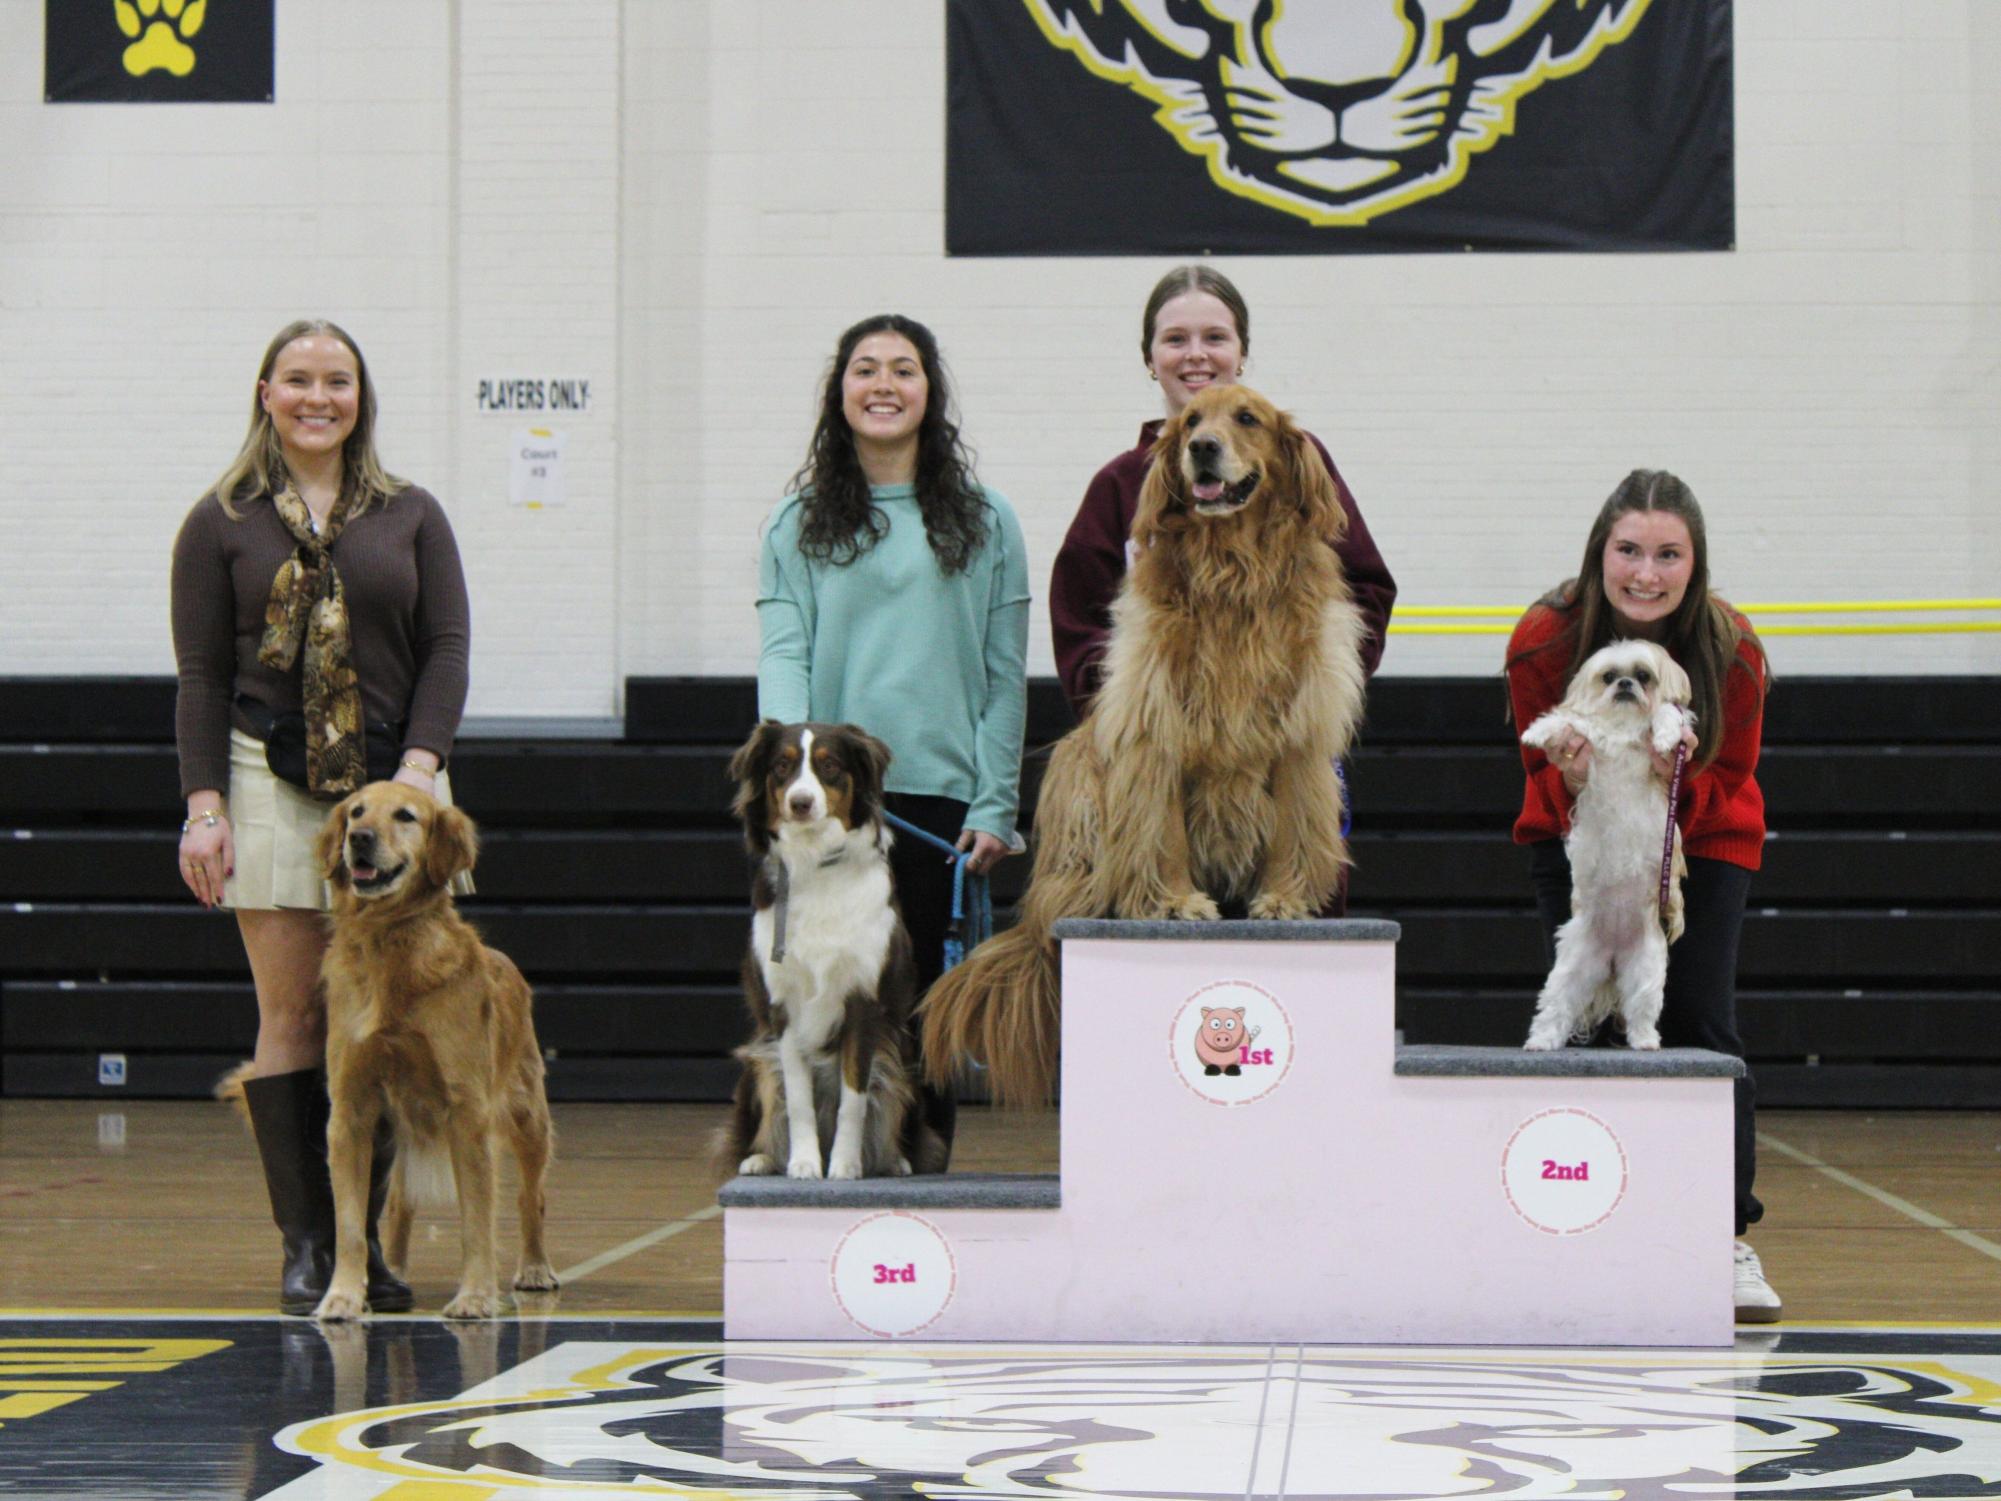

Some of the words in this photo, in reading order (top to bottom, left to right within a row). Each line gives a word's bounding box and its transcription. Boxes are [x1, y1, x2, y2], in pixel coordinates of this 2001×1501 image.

[479, 380, 544, 410] PLAYERS
[550, 380, 589, 410] ONLY
[521, 449, 557, 460] Court
[1238, 1045, 1274, 1065] 1st
[1541, 1159, 1589, 1181] 2nd
[873, 1263, 916, 1284] 3rd
